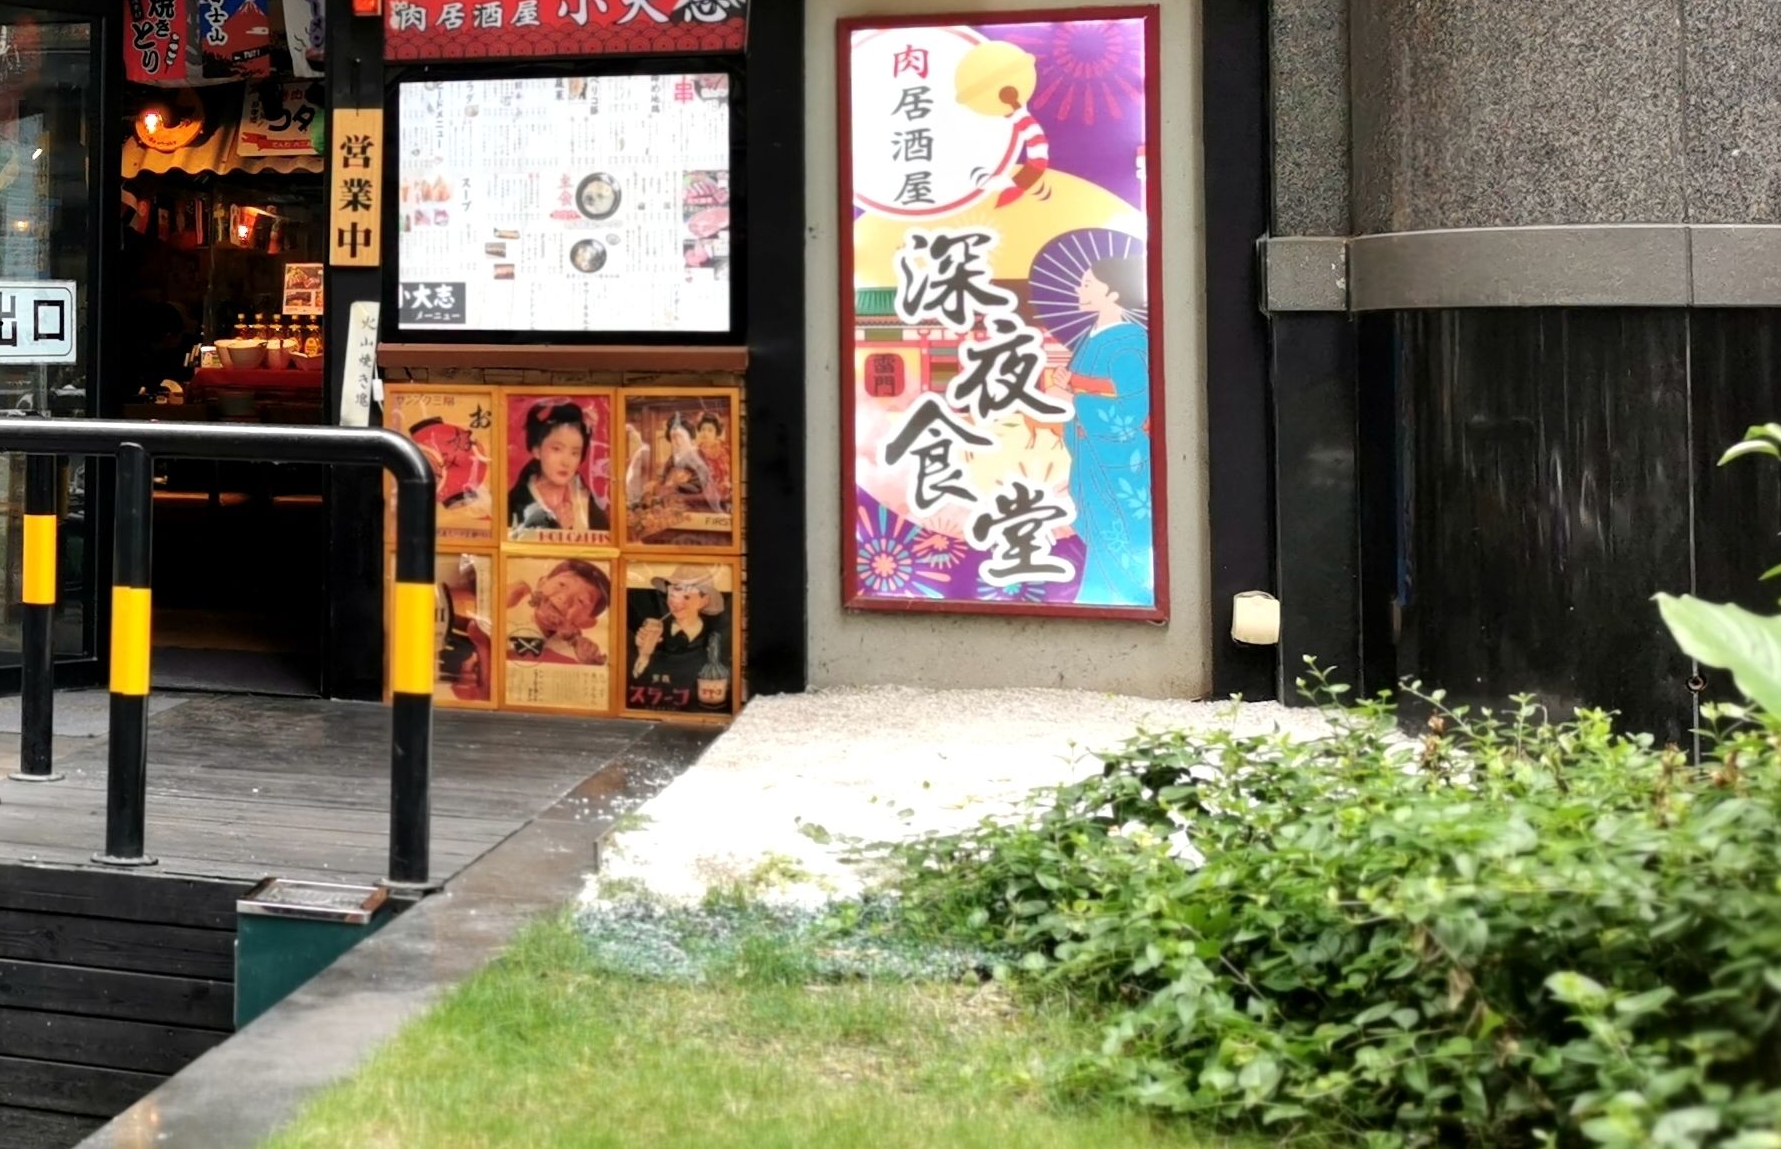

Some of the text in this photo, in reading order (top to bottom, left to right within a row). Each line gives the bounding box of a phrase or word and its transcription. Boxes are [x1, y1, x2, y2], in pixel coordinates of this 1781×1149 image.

[400, 0, 541, 31] 肉居酒屋
[891, 44, 936, 207] 肉居酒屋
[338, 135, 374, 259] 営業中
[872, 354, 897, 397] 雷門
[886, 232, 1074, 580] 深夜食堂
